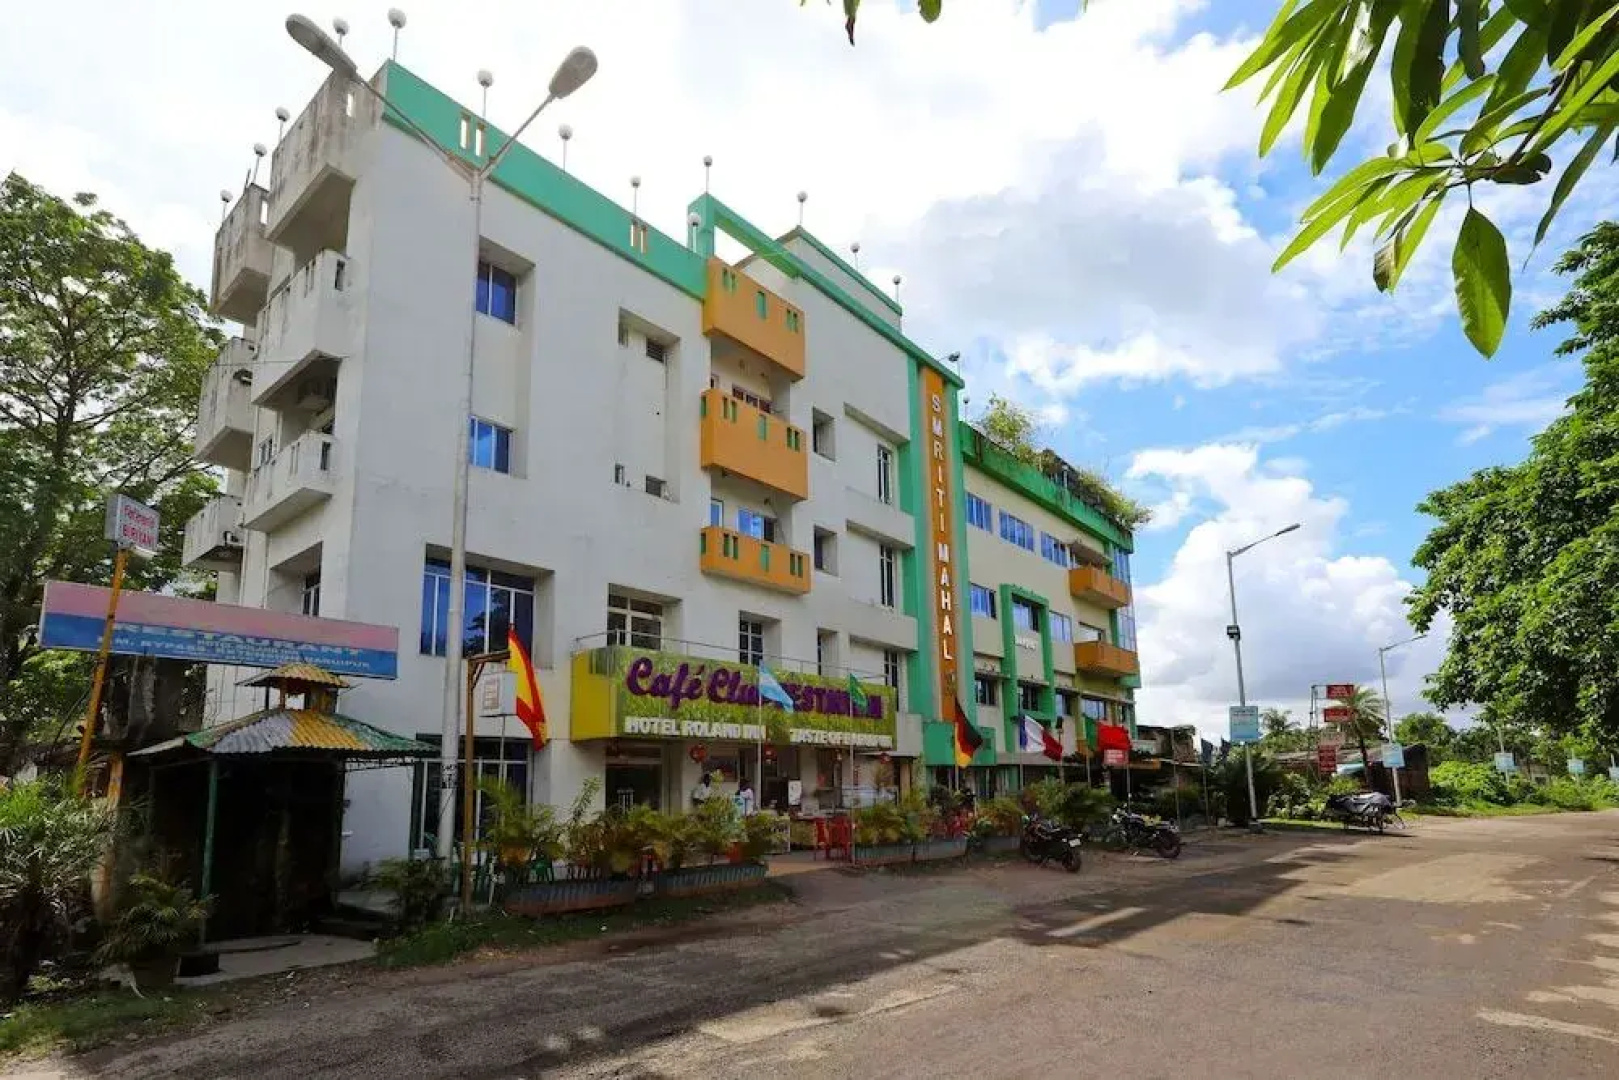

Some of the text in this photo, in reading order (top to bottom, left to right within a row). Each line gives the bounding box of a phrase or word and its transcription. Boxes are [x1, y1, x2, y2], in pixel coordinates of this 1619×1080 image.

[932, 393, 953, 660] SMRITI MAHAL
[626, 657, 704, 711] Café
[707, 668, 774, 707] Clu
[624, 717, 679, 736] HOTEL
